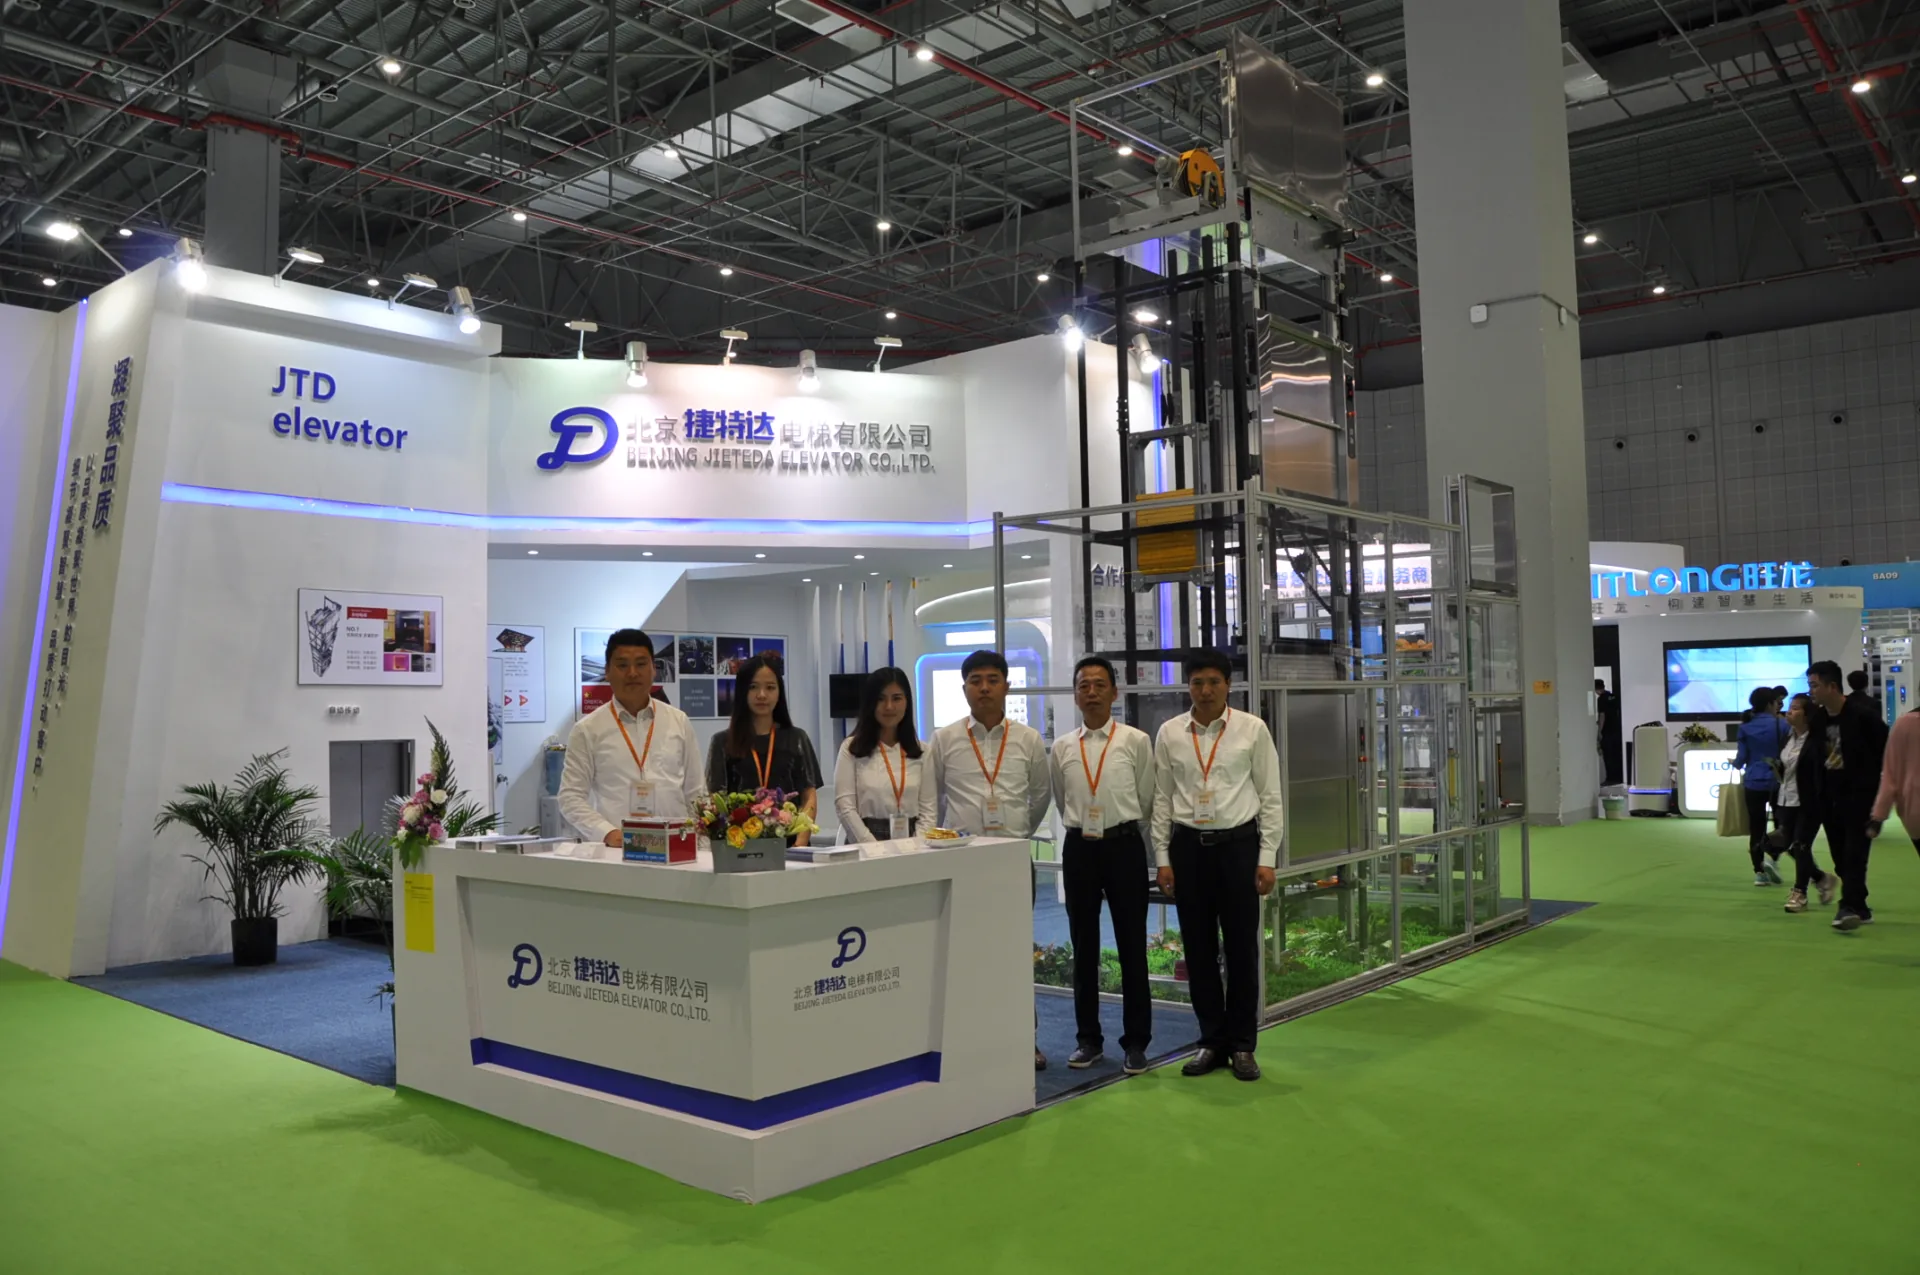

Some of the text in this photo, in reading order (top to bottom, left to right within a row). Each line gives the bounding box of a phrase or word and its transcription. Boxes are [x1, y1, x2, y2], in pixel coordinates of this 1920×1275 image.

[271, 366, 336, 401] JTD
[92, 356, 131, 530] 凝聚品质
[273, 406, 408, 449] elevator
[627, 447, 698, 466] BEIJING
[704, 448, 774, 468] JIETEDA
[781, 451, 863, 470] ELEVATOR
[1091, 564, 1124, 587] 合作
[1701, 761, 1746, 771] ITLO
[548, 956, 708, 1003] 北京捷特达电梯有限公司
[794, 966, 900, 1000] 北京捷特达电梯有限公司
[548, 980, 581, 998] BEIJING
[583, 988, 619, 1005] JIETEDA
[622, 993, 667, 1014] ELEVATOR
[794, 998, 820, 1011] BEIJING
[821, 992, 847, 1005] JIETEDA
[847, 985, 877, 999] ELEVATOR
